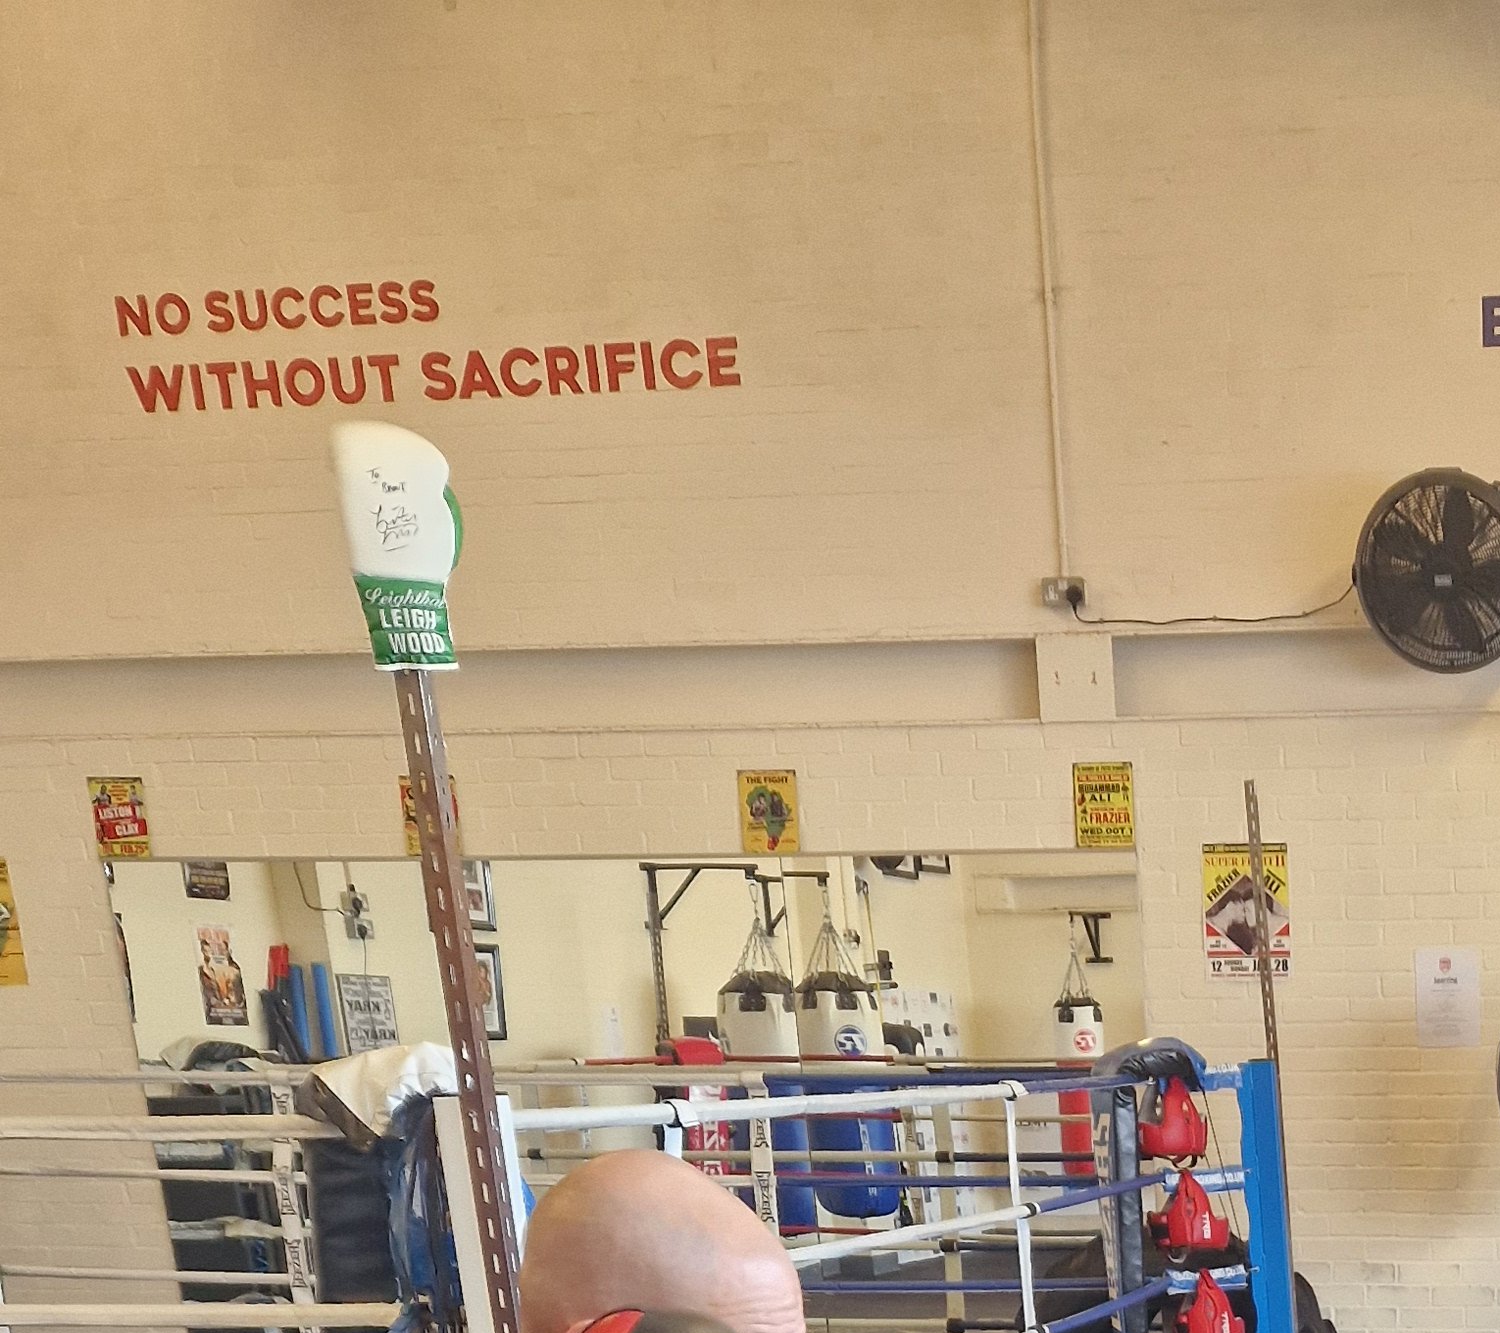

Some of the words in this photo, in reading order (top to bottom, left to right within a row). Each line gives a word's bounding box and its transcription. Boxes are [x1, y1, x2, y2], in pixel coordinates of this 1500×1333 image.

[114, 292, 191, 337] NO
[204, 279, 440, 333] SUCCESS
[125, 354, 400, 413] WITHOUT
[420, 336, 742, 401] SACRIFICE
[379, 608, 437, 630] LEIGH
[388, 632, 446, 654] WOOD
[1089, 793, 1111, 802] ALI
[1206, 867, 1241, 902] FRAZIER
[1211, 960, 1223, 972] 12
[753, 1170, 776, 1223] GEEZERS
